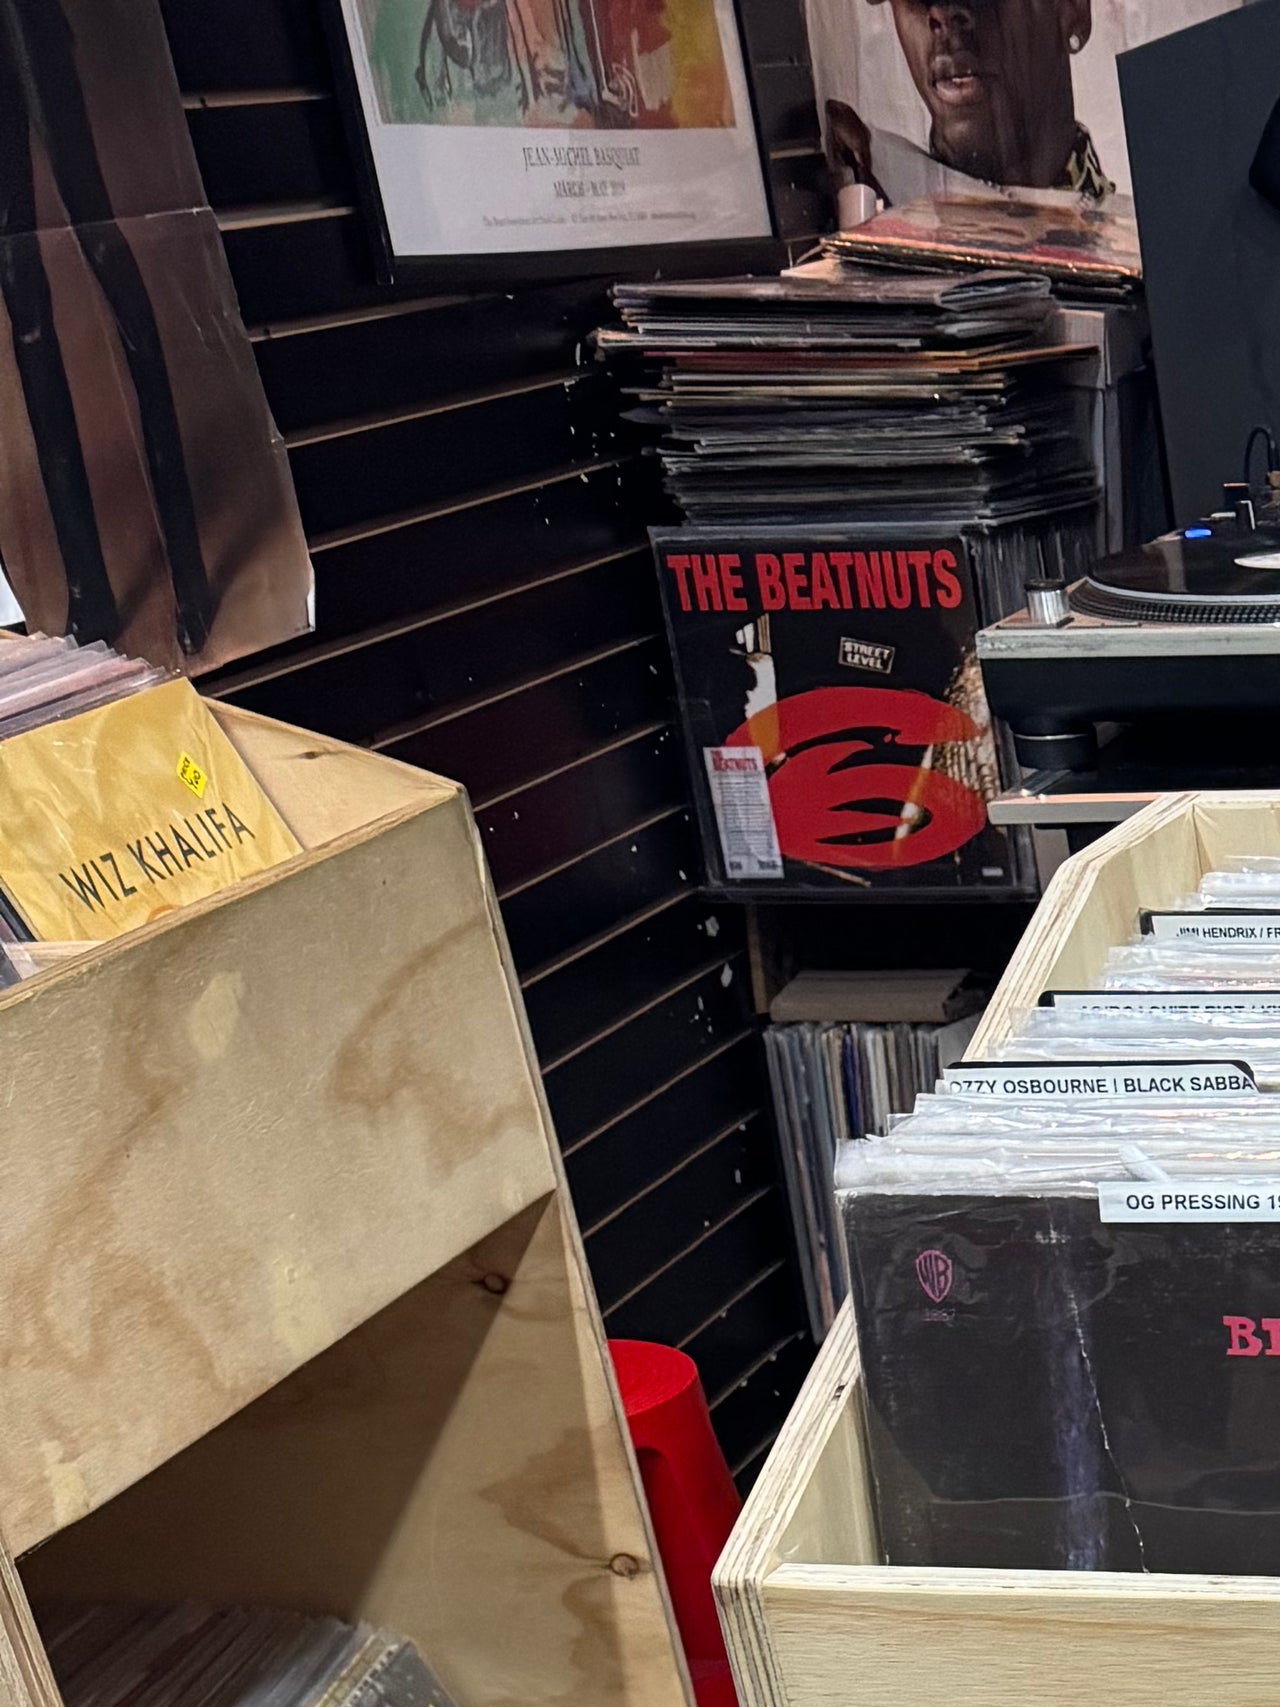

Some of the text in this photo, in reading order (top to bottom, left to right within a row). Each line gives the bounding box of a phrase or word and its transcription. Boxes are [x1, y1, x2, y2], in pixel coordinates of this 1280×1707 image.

[667, 549, 963, 612] THE BEATNUTS
[843, 640, 891, 659] STREET
[846, 653, 885, 671] LEVEL
[58, 802, 256, 913] WIZ KHALIFA
[1202, 926, 1257, 939] HENDRIX
[949, 1079, 999, 1095] OZZY
[1002, 1078, 1109, 1094] OSBOURNE
[1124, 1076, 1187, 1094] BLACK
[1125, 1193, 1155, 1211] OG
[1161, 1193, 1261, 1211] PRESSING
